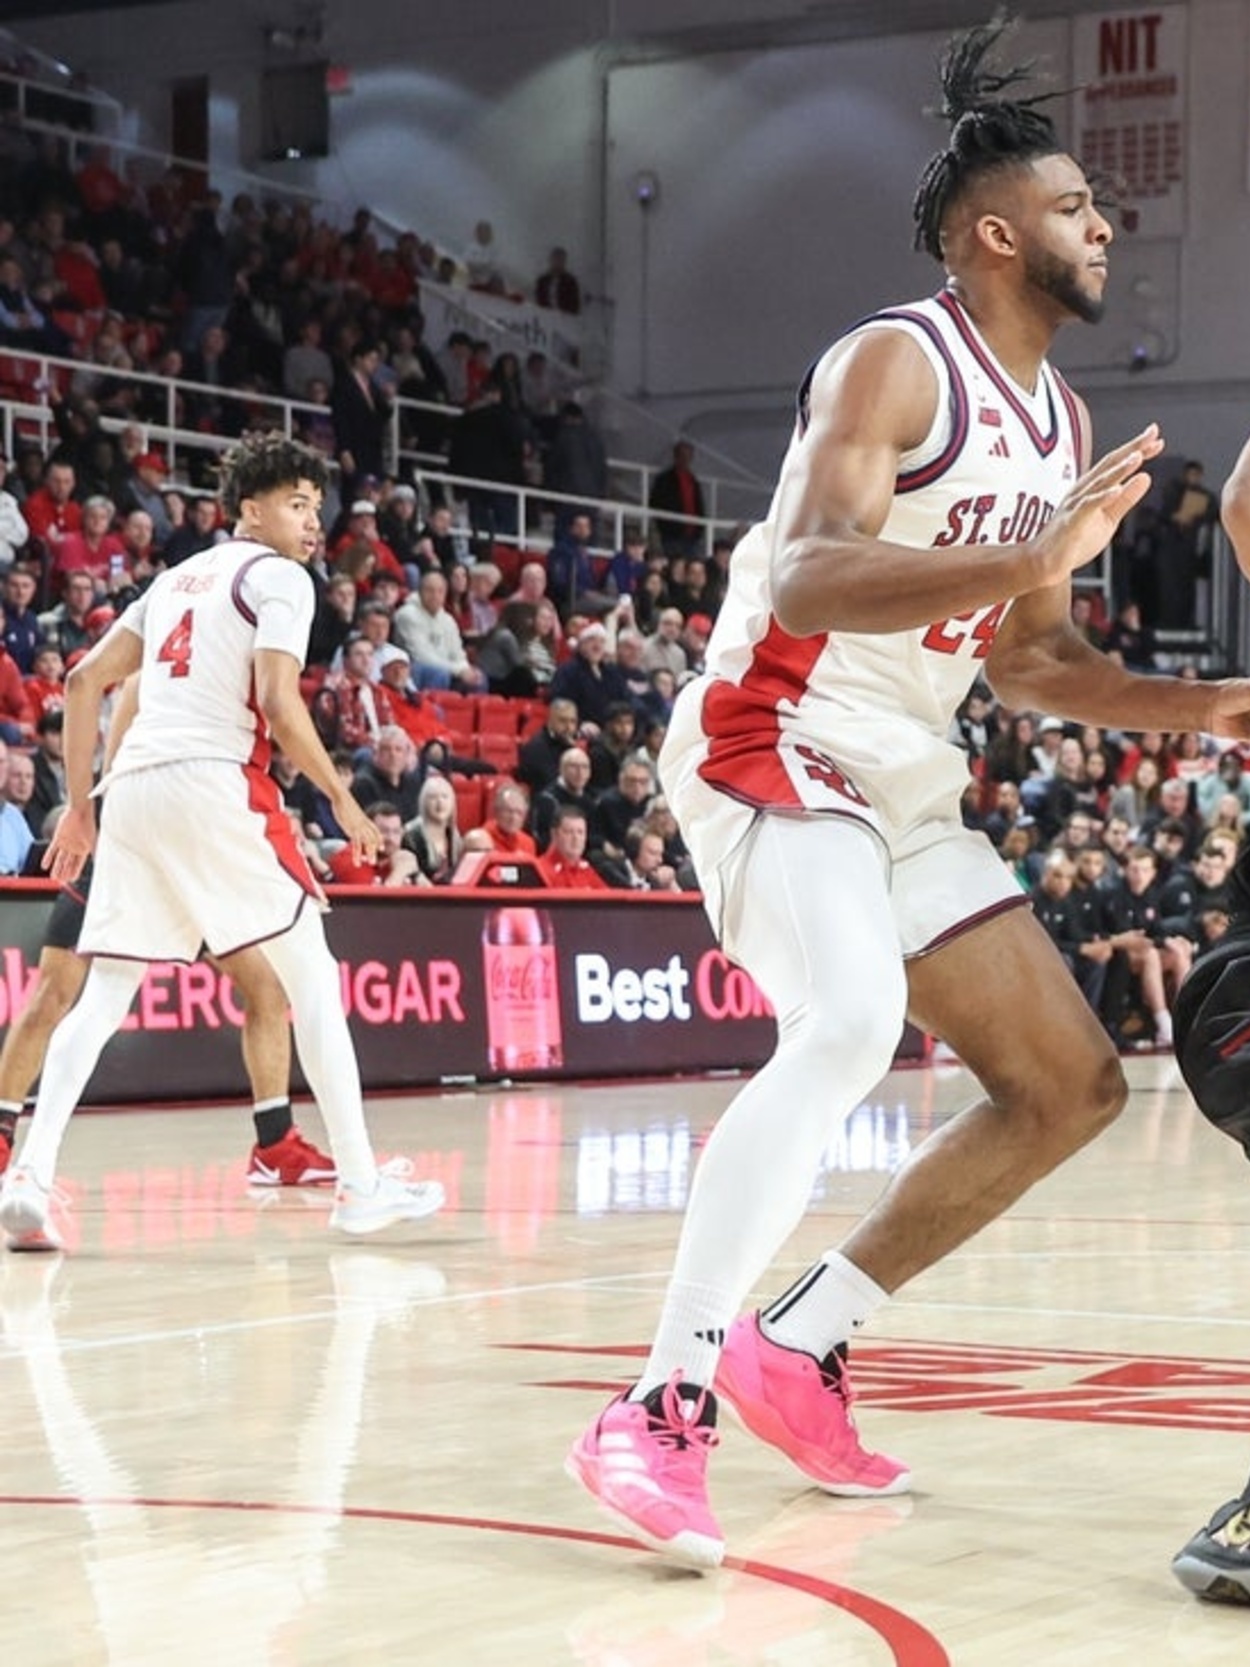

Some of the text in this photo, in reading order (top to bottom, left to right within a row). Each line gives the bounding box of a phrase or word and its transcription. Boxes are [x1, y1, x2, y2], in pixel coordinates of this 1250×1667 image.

[1099, 15, 1162, 76] NIT
[156, 607, 194, 678] 4
[575, 953, 692, 1023] Best
